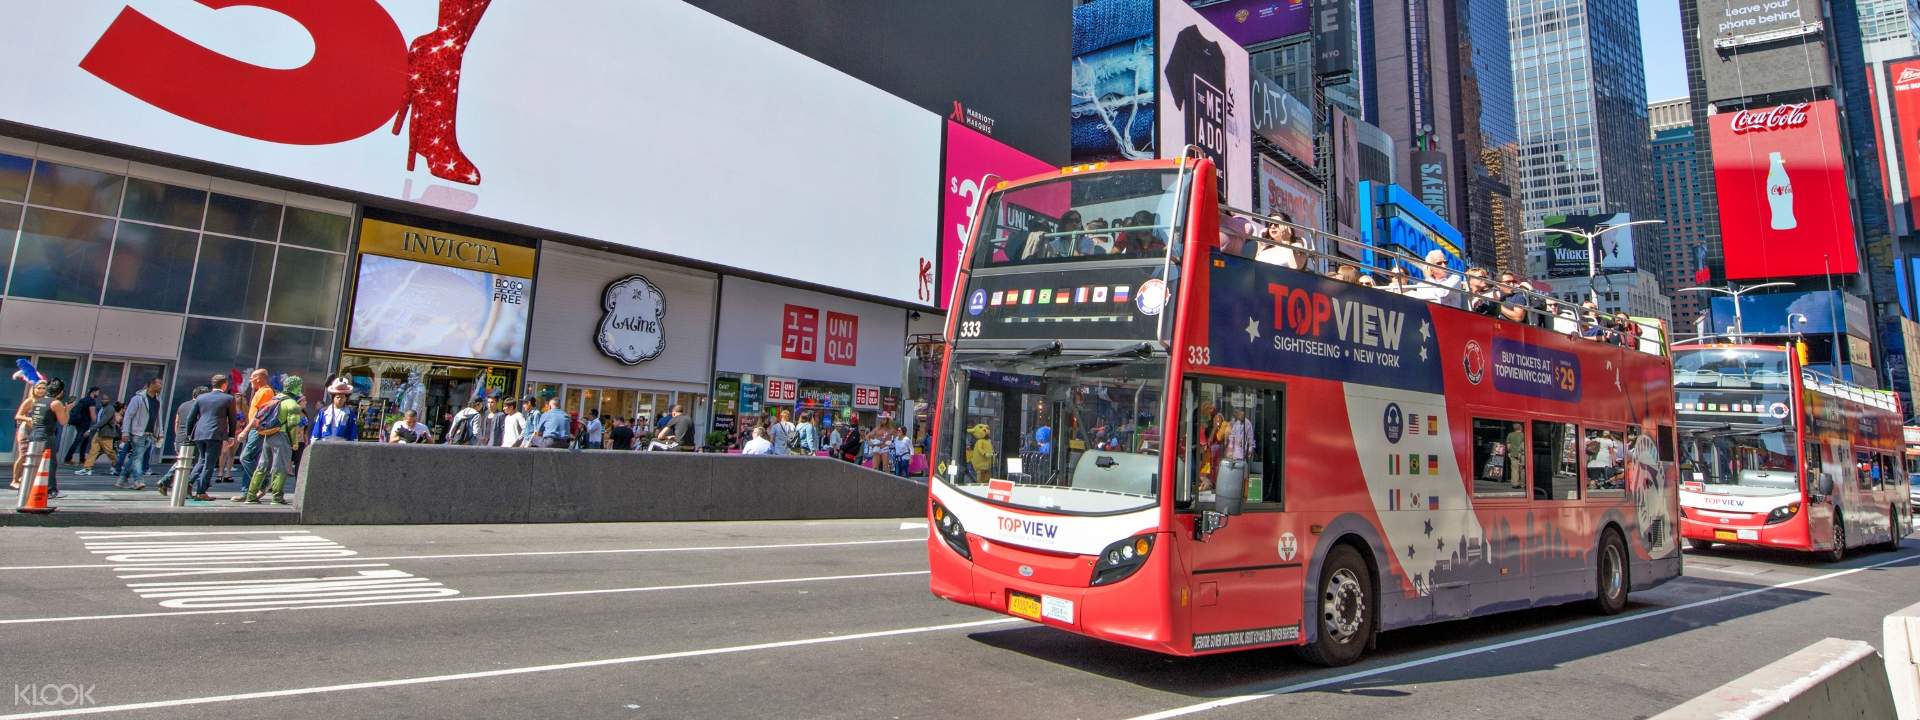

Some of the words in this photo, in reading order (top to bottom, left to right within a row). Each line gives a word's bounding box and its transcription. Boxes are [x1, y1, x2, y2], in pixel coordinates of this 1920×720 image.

[1725, 4, 1760, 17] Leave
[1763, 0, 1789, 13] your
[1718, 18, 1756, 33] phone
[1758, 8, 1801, 24] behind
[1252, 80, 1287, 129] CATS
[966, 107, 994, 126] MARRIOTT
[966, 116, 991, 134] MARQUIS
[1731, 103, 1809, 133] Coca-Cola
[402, 231, 501, 266] INVICTA
[1553, 247, 1589, 260] WICKE
[495, 278, 523, 291] BOGO
[493, 293, 521, 305] FREE
[1267, 282, 1405, 351] TOPVIEW
[960, 321, 981, 338] 333
[1188, 345, 1210, 366] 333
[1273, 335, 1341, 359] SIGHTSEEING
[1353, 349, 1374, 364] NEW
[1376, 352, 1400, 368] YORK
[1502, 351, 1515, 364] BUY
[1515, 354, 1542, 371] TICKETS
[1542, 360, 1551, 371] AT
[1495, 364, 1552, 385] TOPVIEWNYC.COM
[1704, 497, 1744, 507] TOPVIEW
[997, 516, 1058, 539] TOPVIEW
